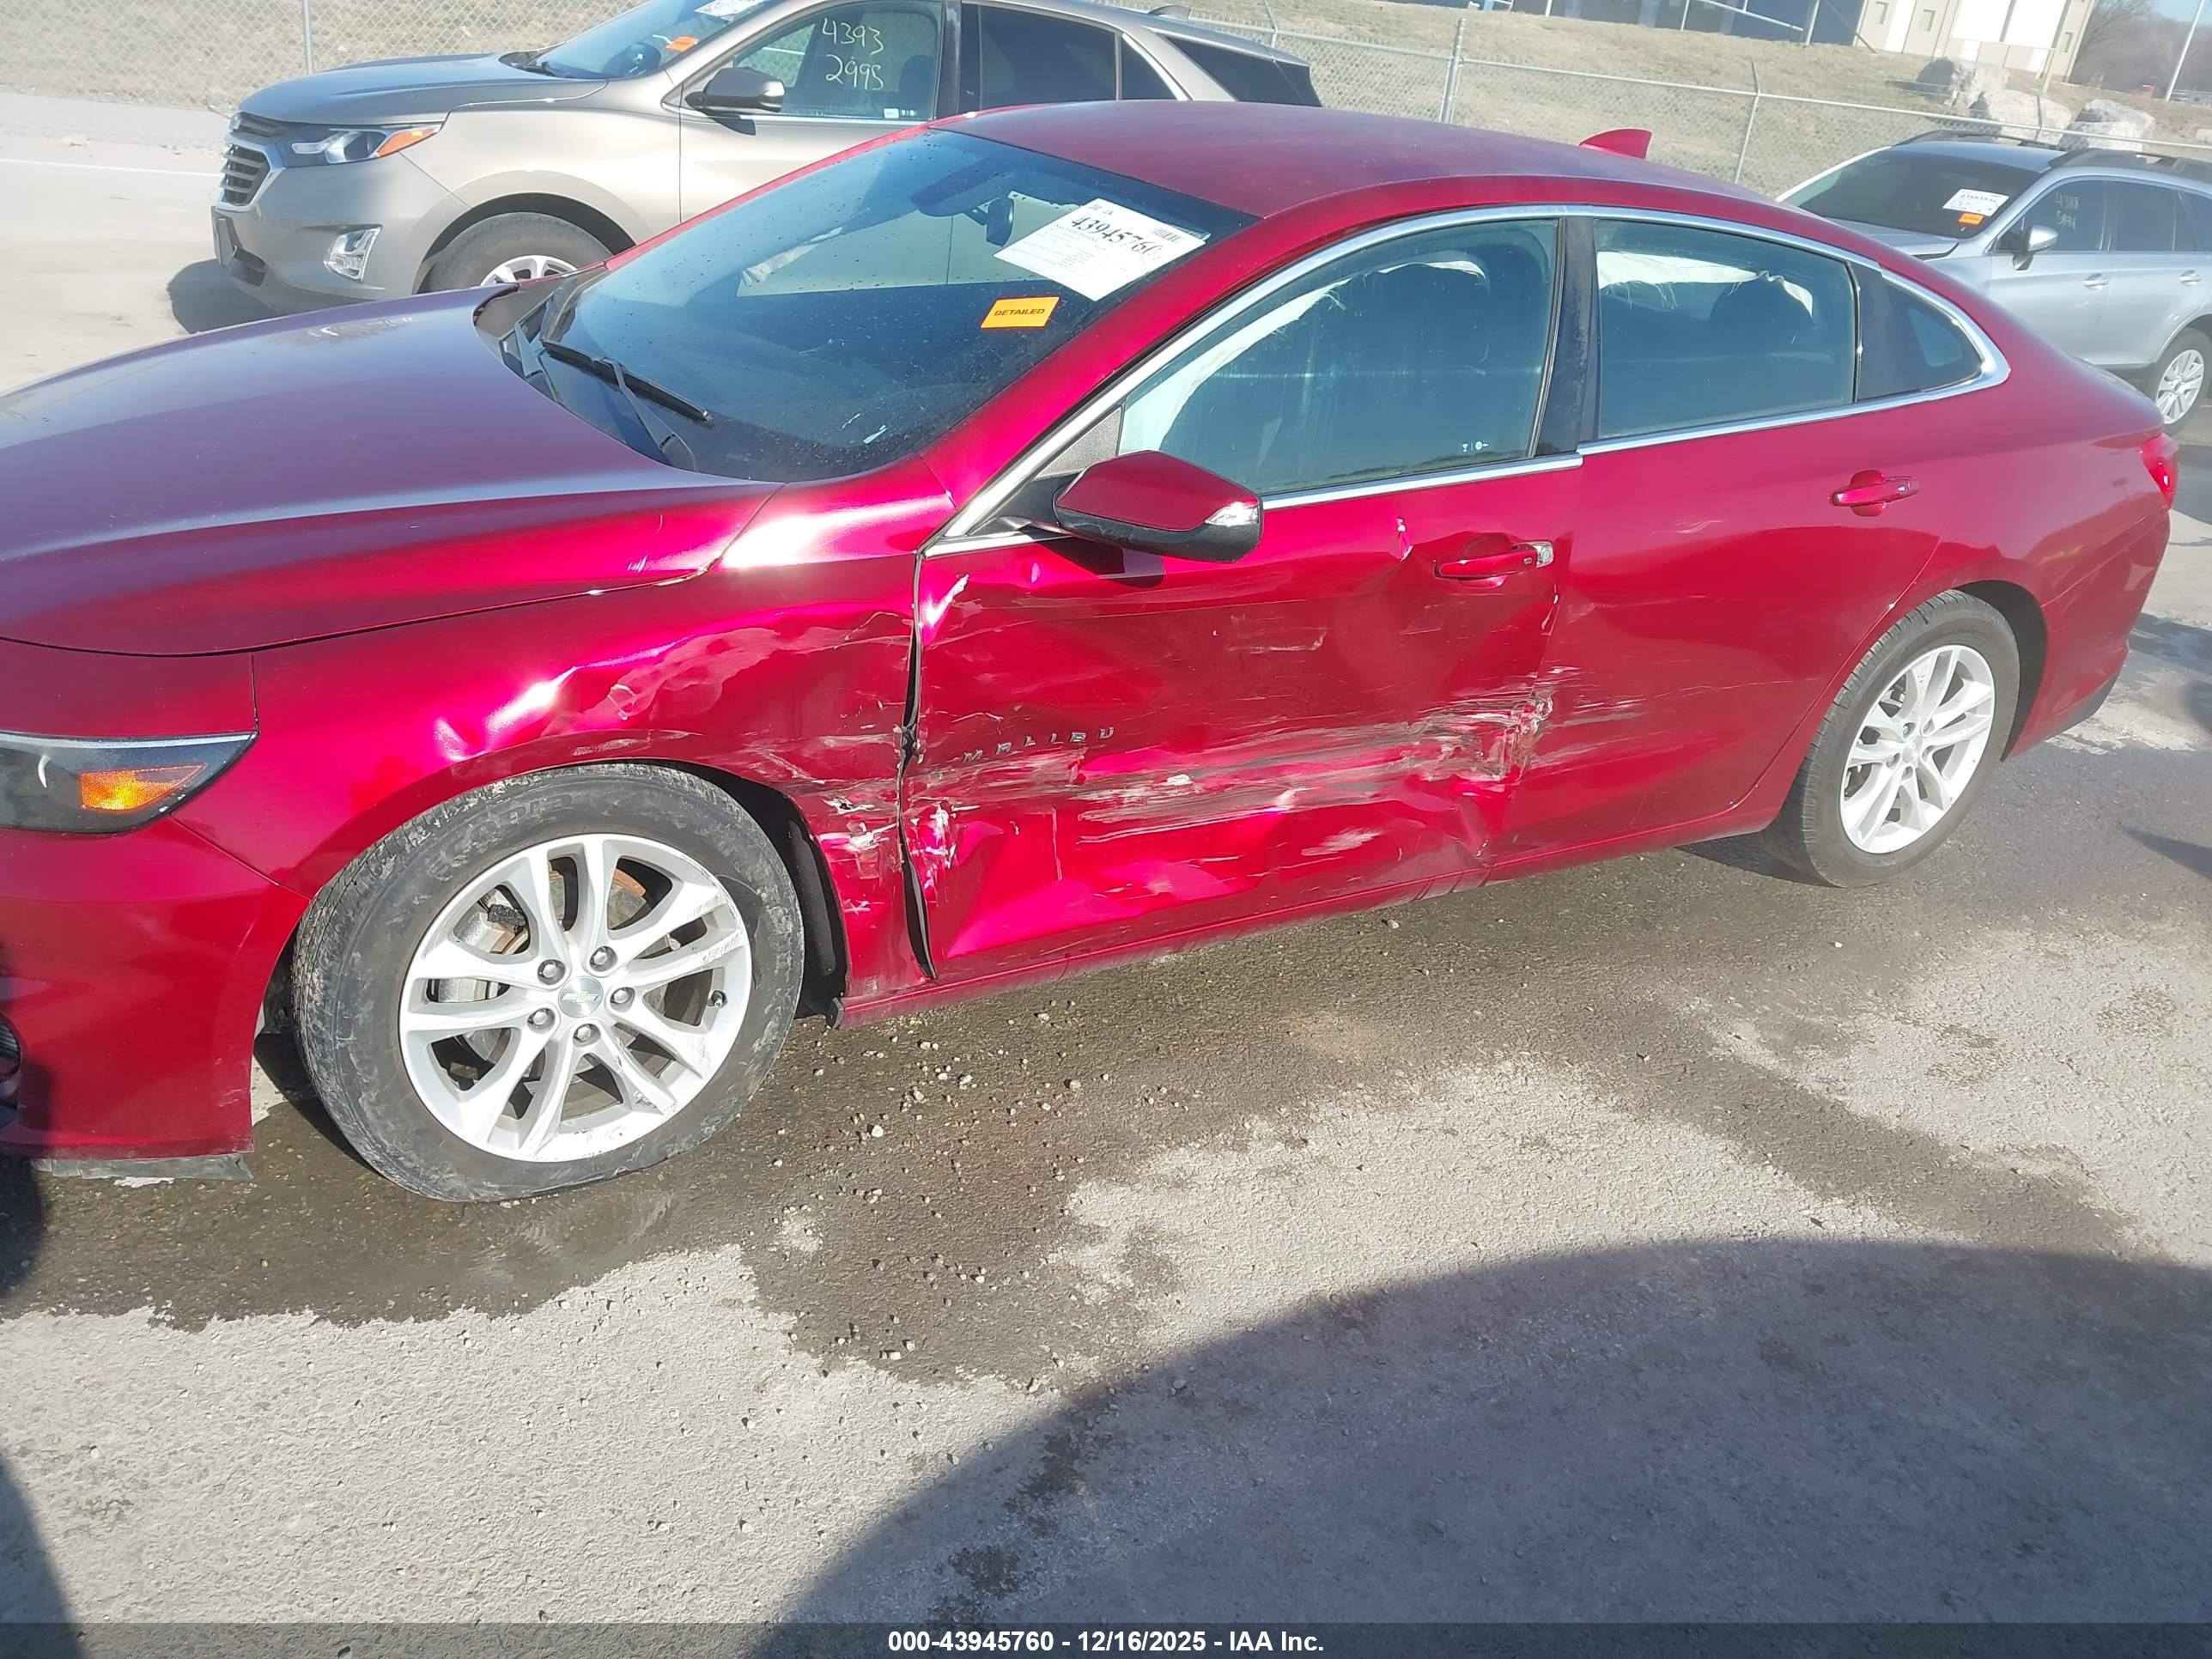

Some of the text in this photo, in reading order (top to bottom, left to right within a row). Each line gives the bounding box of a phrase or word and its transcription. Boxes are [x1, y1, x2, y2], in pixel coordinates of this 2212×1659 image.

[823, 17, 884, 56] 4393
[825, 54, 884, 91] 2995
[994, 308, 1046, 317] DETAILED
[961, 726, 1115, 764] MALIBU
